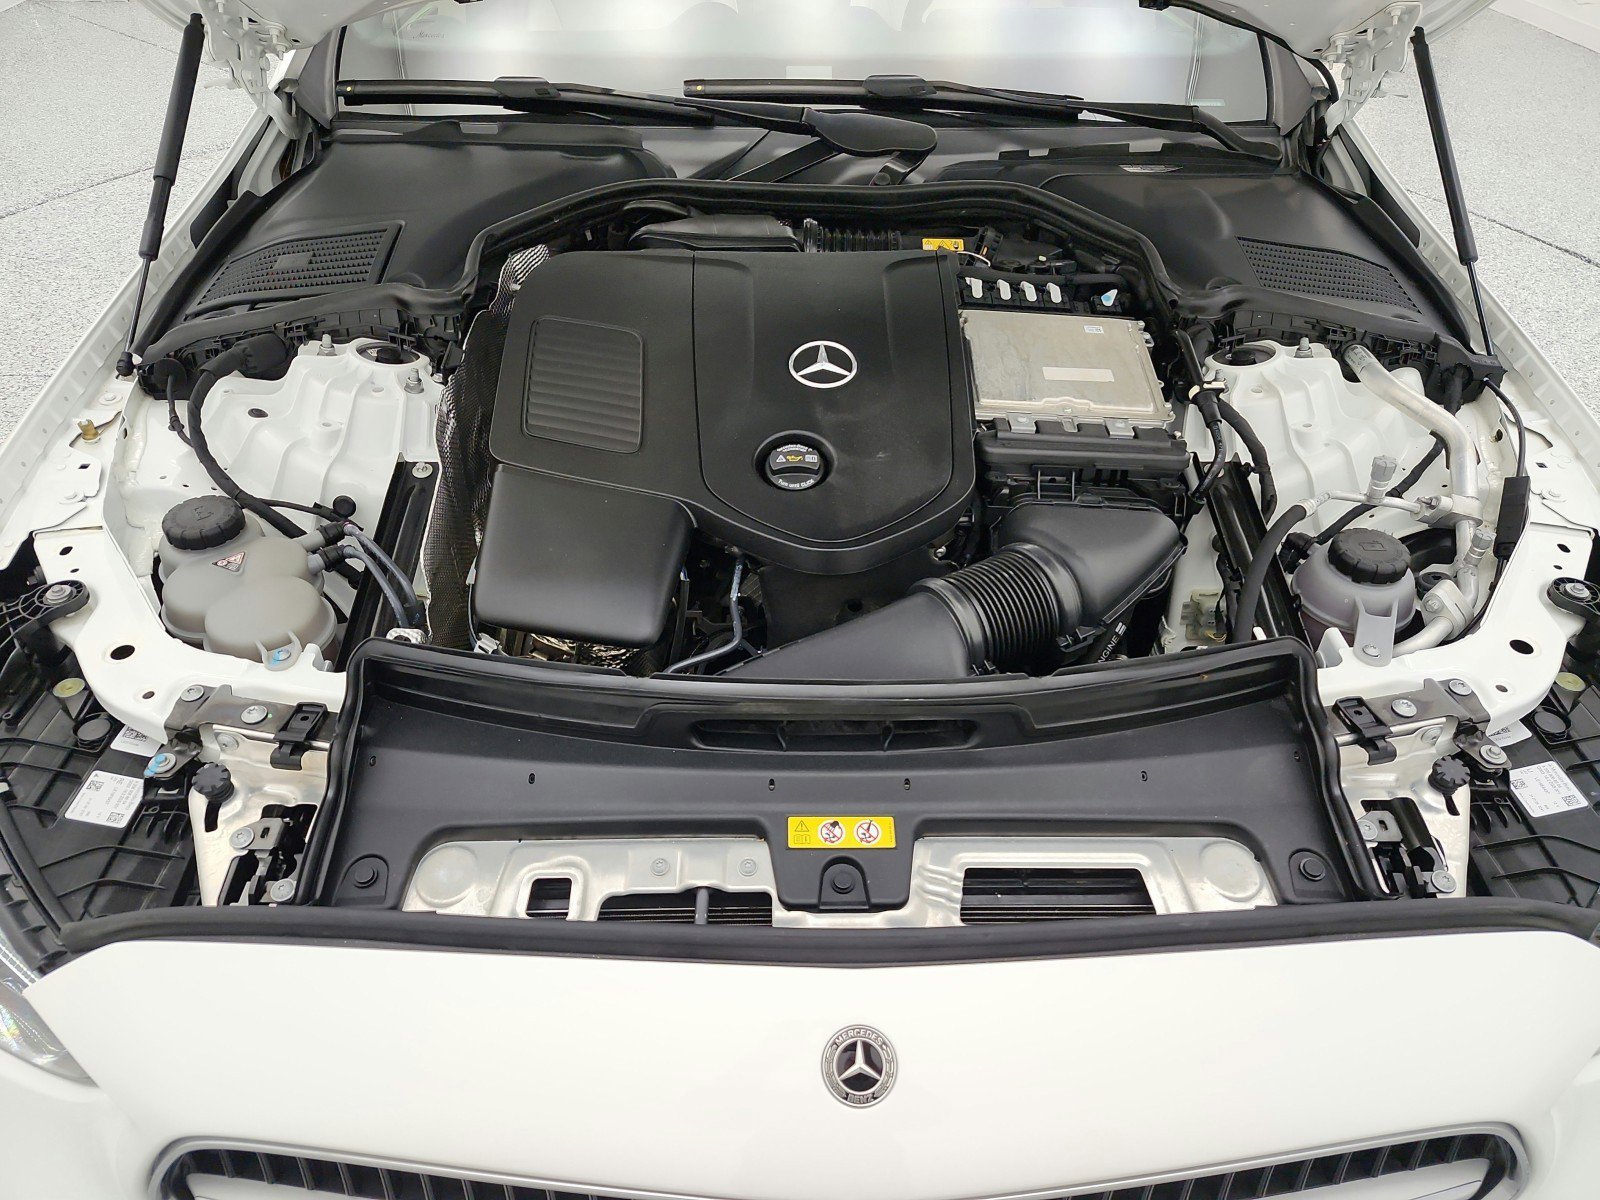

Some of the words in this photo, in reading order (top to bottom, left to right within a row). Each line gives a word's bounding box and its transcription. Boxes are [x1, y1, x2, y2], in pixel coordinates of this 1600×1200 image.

[1097, 634, 1120, 664] NGINE
[835, 1028, 884, 1046] MERCEDES
[846, 1092, 875, 1104] BENZ
